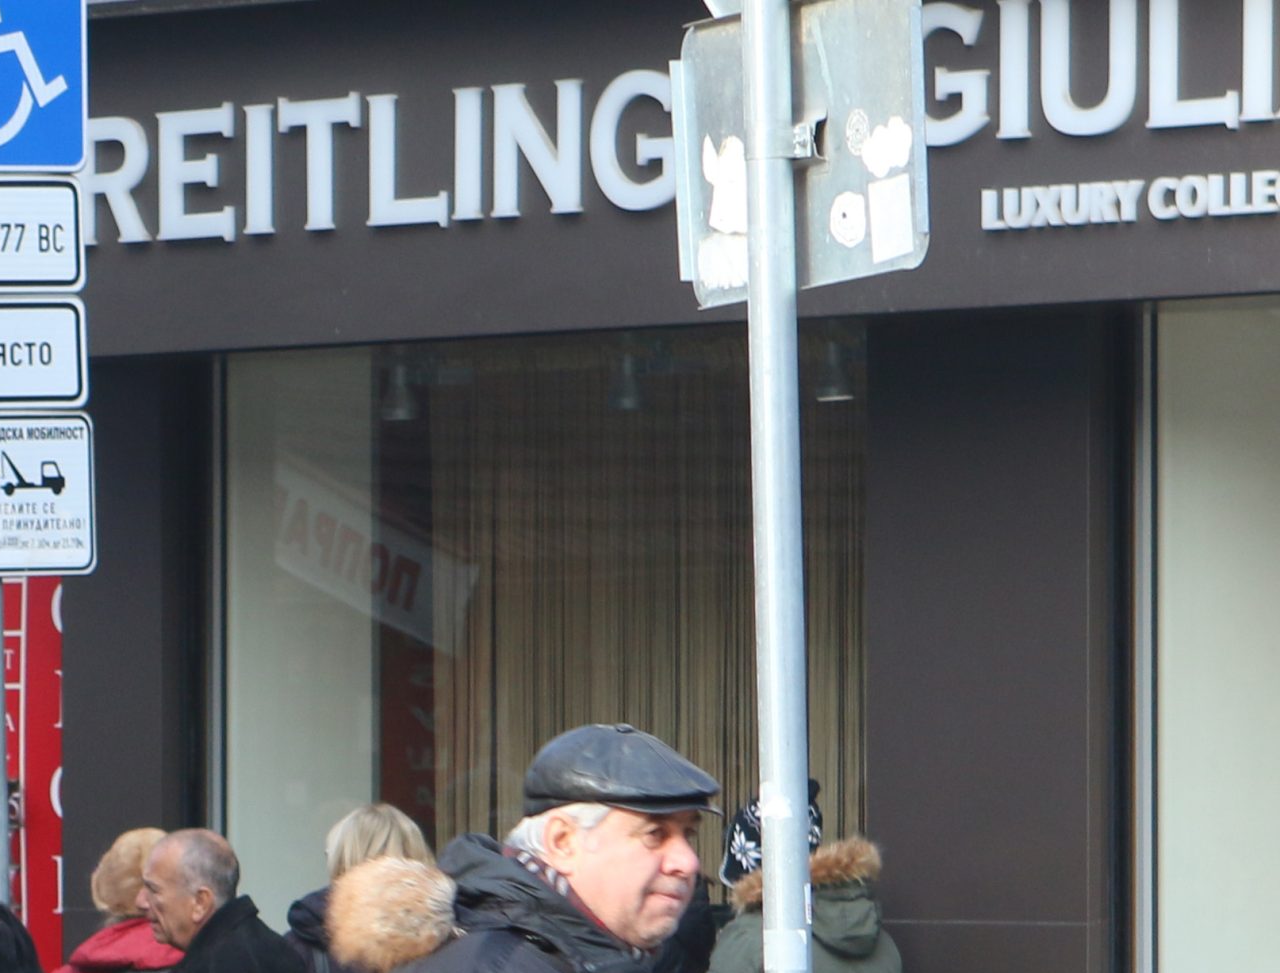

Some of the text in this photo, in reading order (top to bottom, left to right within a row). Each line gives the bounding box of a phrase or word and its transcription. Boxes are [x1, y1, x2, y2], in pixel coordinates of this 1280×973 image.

[923, 0, 1280, 147] GIULI
[981, 171, 1280, 231] LUXURY COLLE
[38, 224, 65, 253] BC
[26, 426, 85, 441] МОБИЛНОСТ
[42, 502, 57, 515] СЕ
